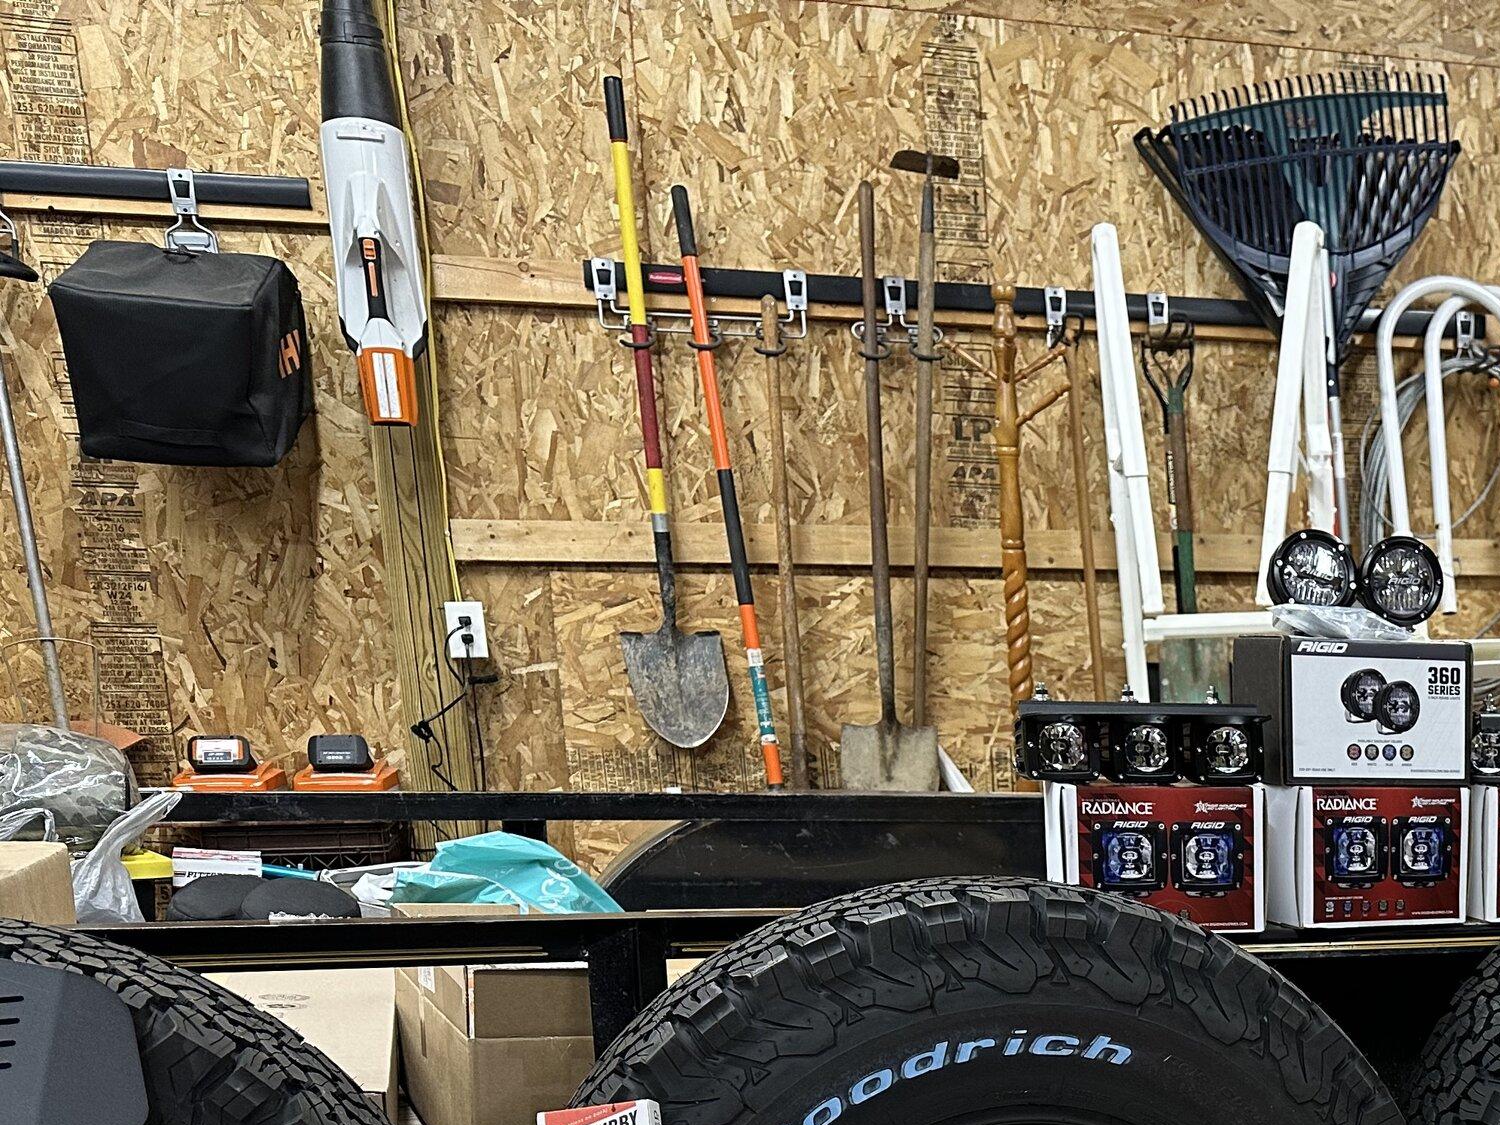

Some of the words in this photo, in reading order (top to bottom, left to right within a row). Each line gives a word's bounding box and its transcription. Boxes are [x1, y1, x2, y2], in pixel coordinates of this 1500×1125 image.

[15, 34, 61, 43] INSTALLATION
[18, 42, 61, 51] INFORMATION
[53, 62, 74, 71] PANELS
[16, 102, 81, 115] 253-620-7400
[953, 417, 992, 442] LP
[79, 491, 136, 507] APA
[1387, 577, 1422, 585] RIGID
[107, 590, 132, 600] W24
[1297, 641, 1349, 653] RIGID
[1428, 667, 1461, 685] 360
[1428, 685, 1461, 695] SERIES
[1082, 802, 1153, 815] RADIANCE
[1316, 798, 1377, 811] RADIANCE
[1113, 821, 1149, 829] RIGID
